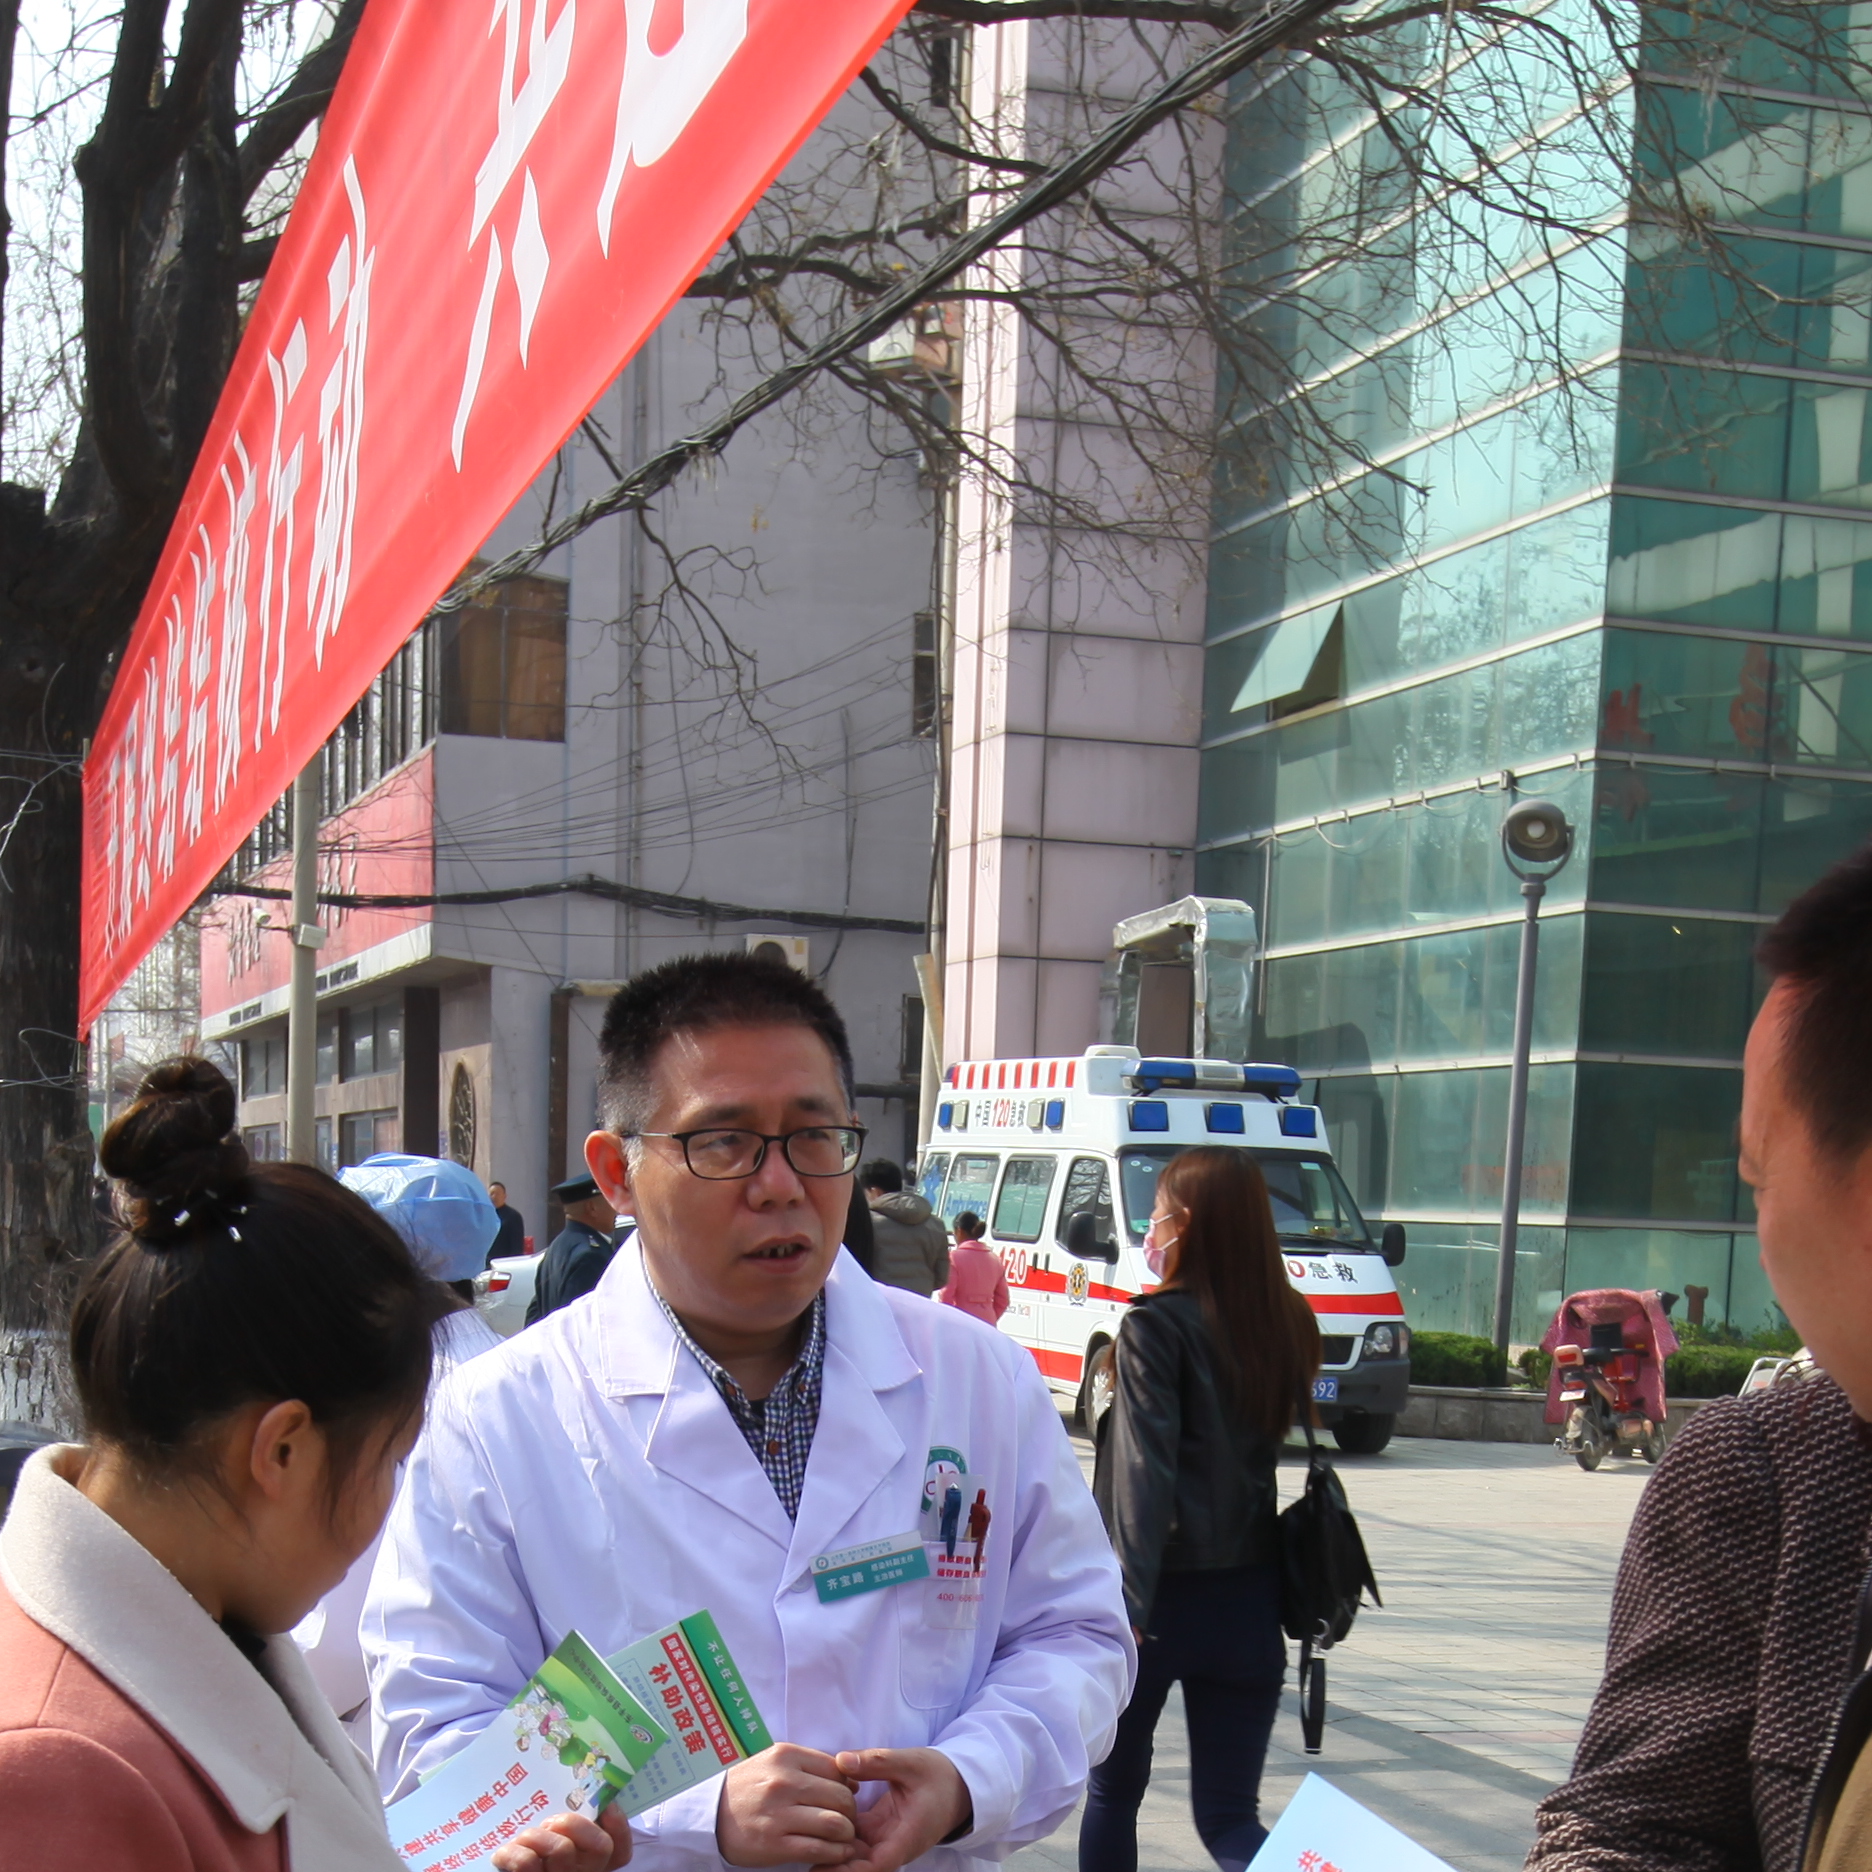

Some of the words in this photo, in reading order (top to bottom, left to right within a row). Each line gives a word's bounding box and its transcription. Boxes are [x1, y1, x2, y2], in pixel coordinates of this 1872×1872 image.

[648, 1661, 708, 1756] 补助政策
[707, 1640, 759, 1735] 不让任何人掉队
